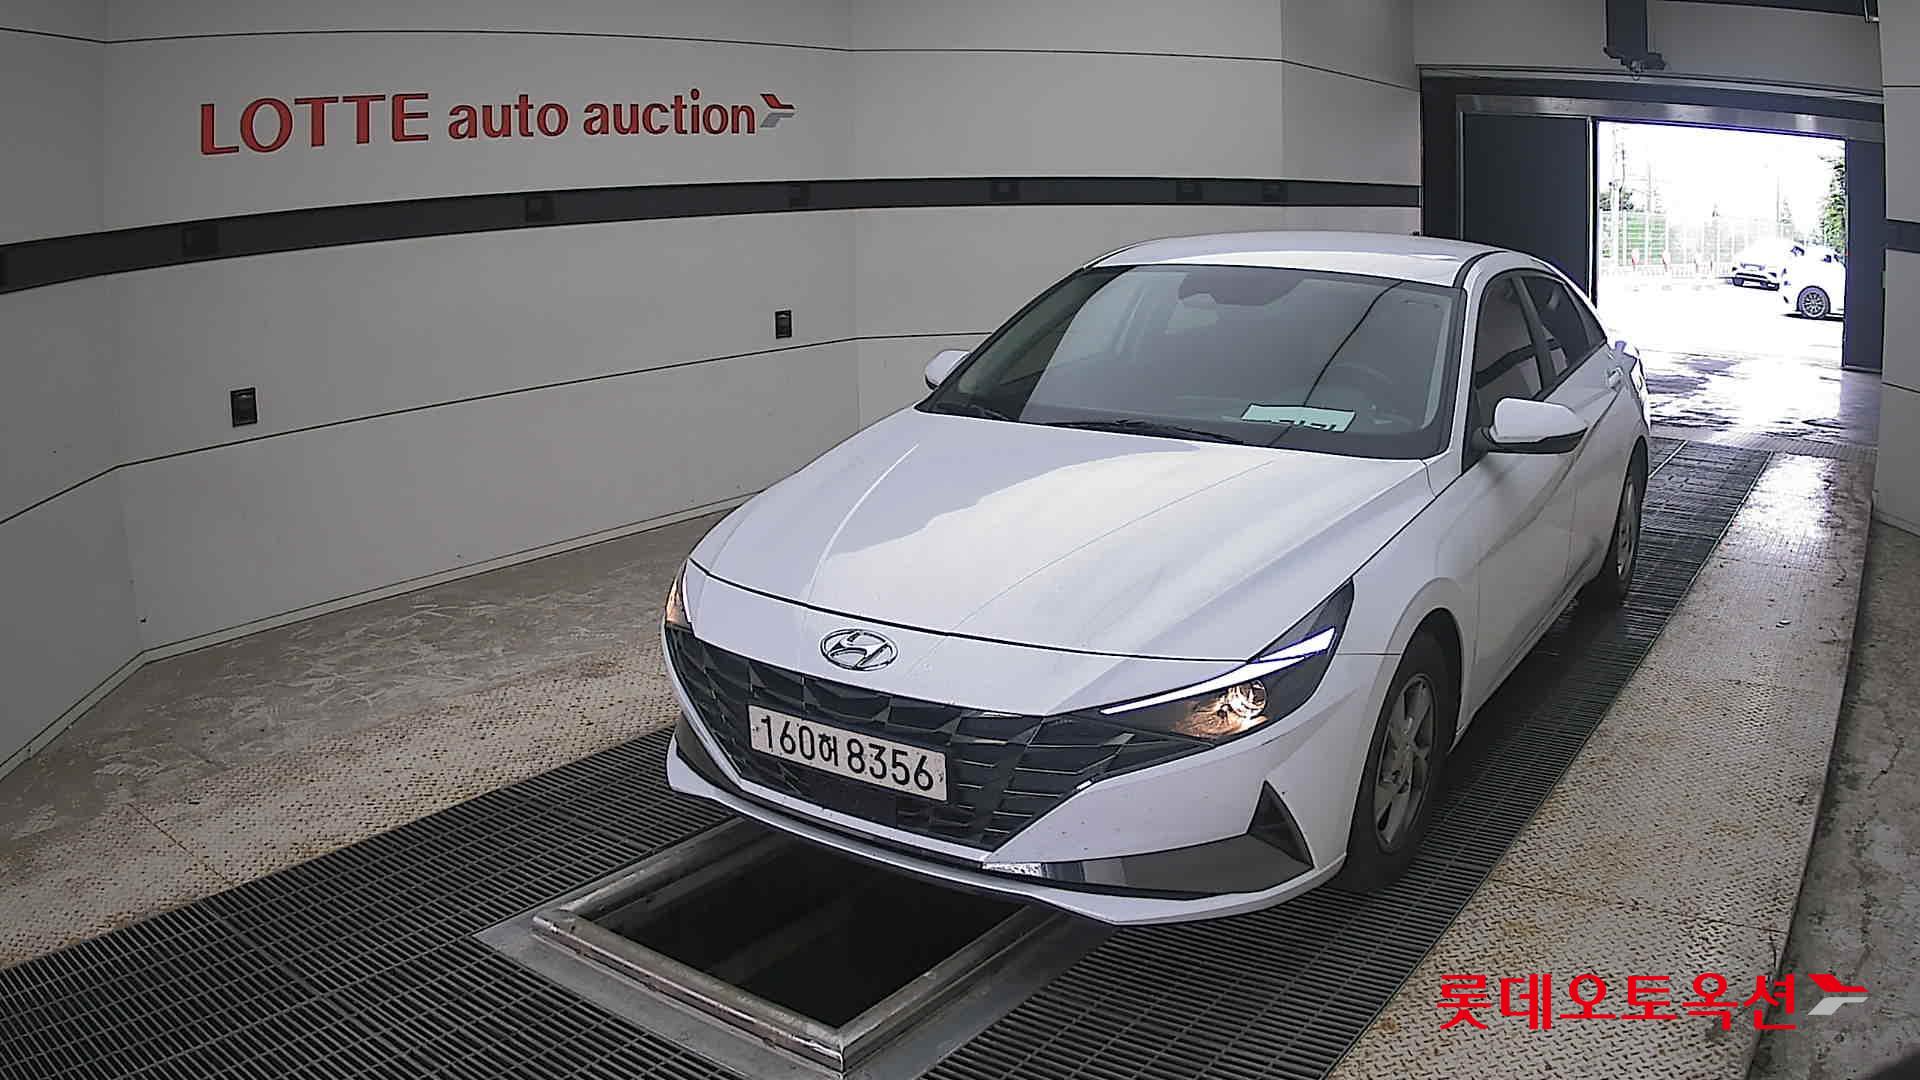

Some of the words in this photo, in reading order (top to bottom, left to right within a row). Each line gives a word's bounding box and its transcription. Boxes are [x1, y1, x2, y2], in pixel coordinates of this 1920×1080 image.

[200, 93, 429, 155] LOTTE
[448, 94, 569, 140] auto
[583, 88, 757, 136] auction
